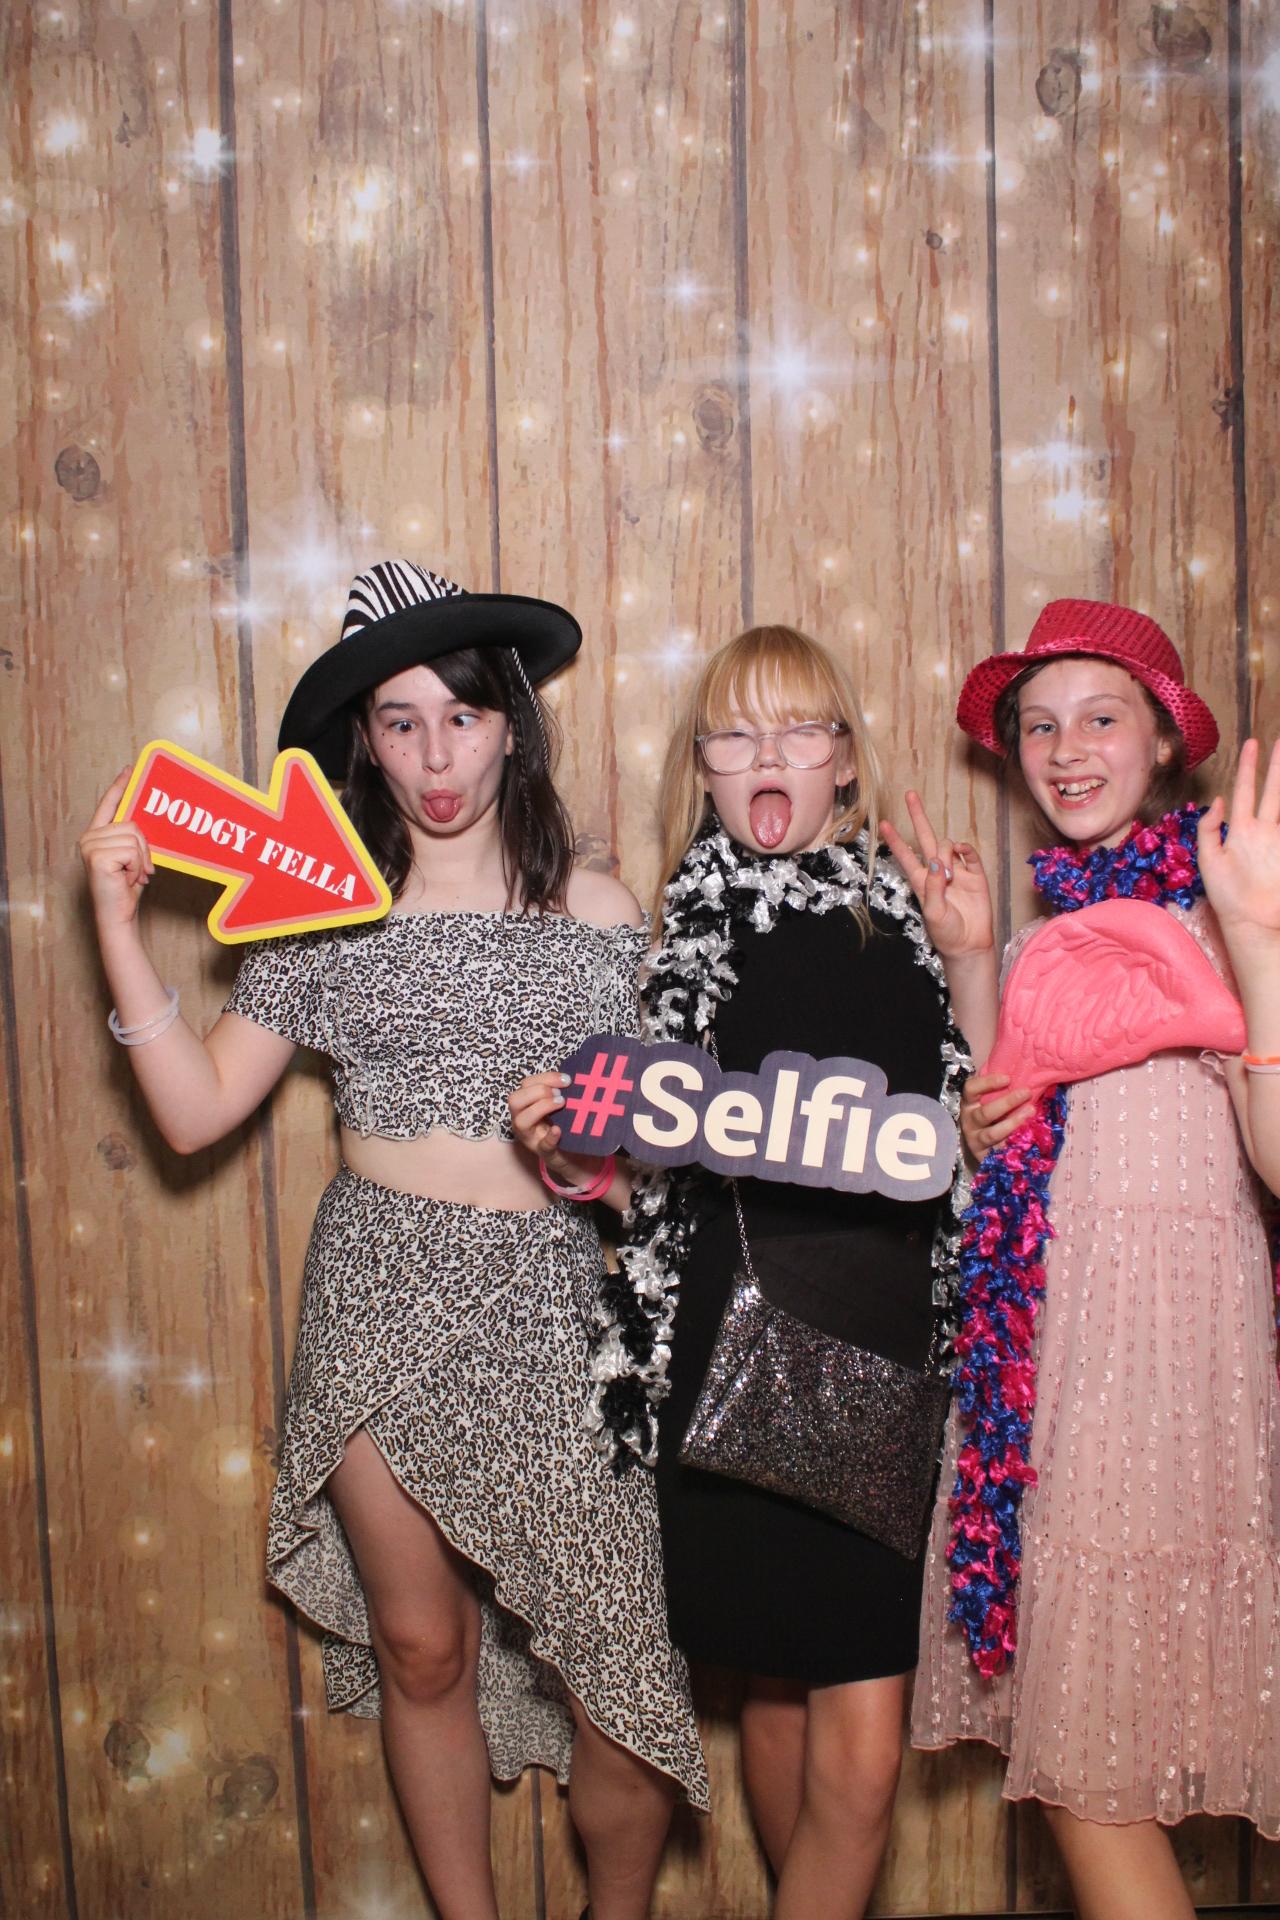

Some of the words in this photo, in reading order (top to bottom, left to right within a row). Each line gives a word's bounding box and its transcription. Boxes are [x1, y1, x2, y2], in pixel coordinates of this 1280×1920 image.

[143, 787, 256, 854] DODGY
[257, 837, 357, 902] FELLA
[565, 1052, 937, 1181] #Selfie
